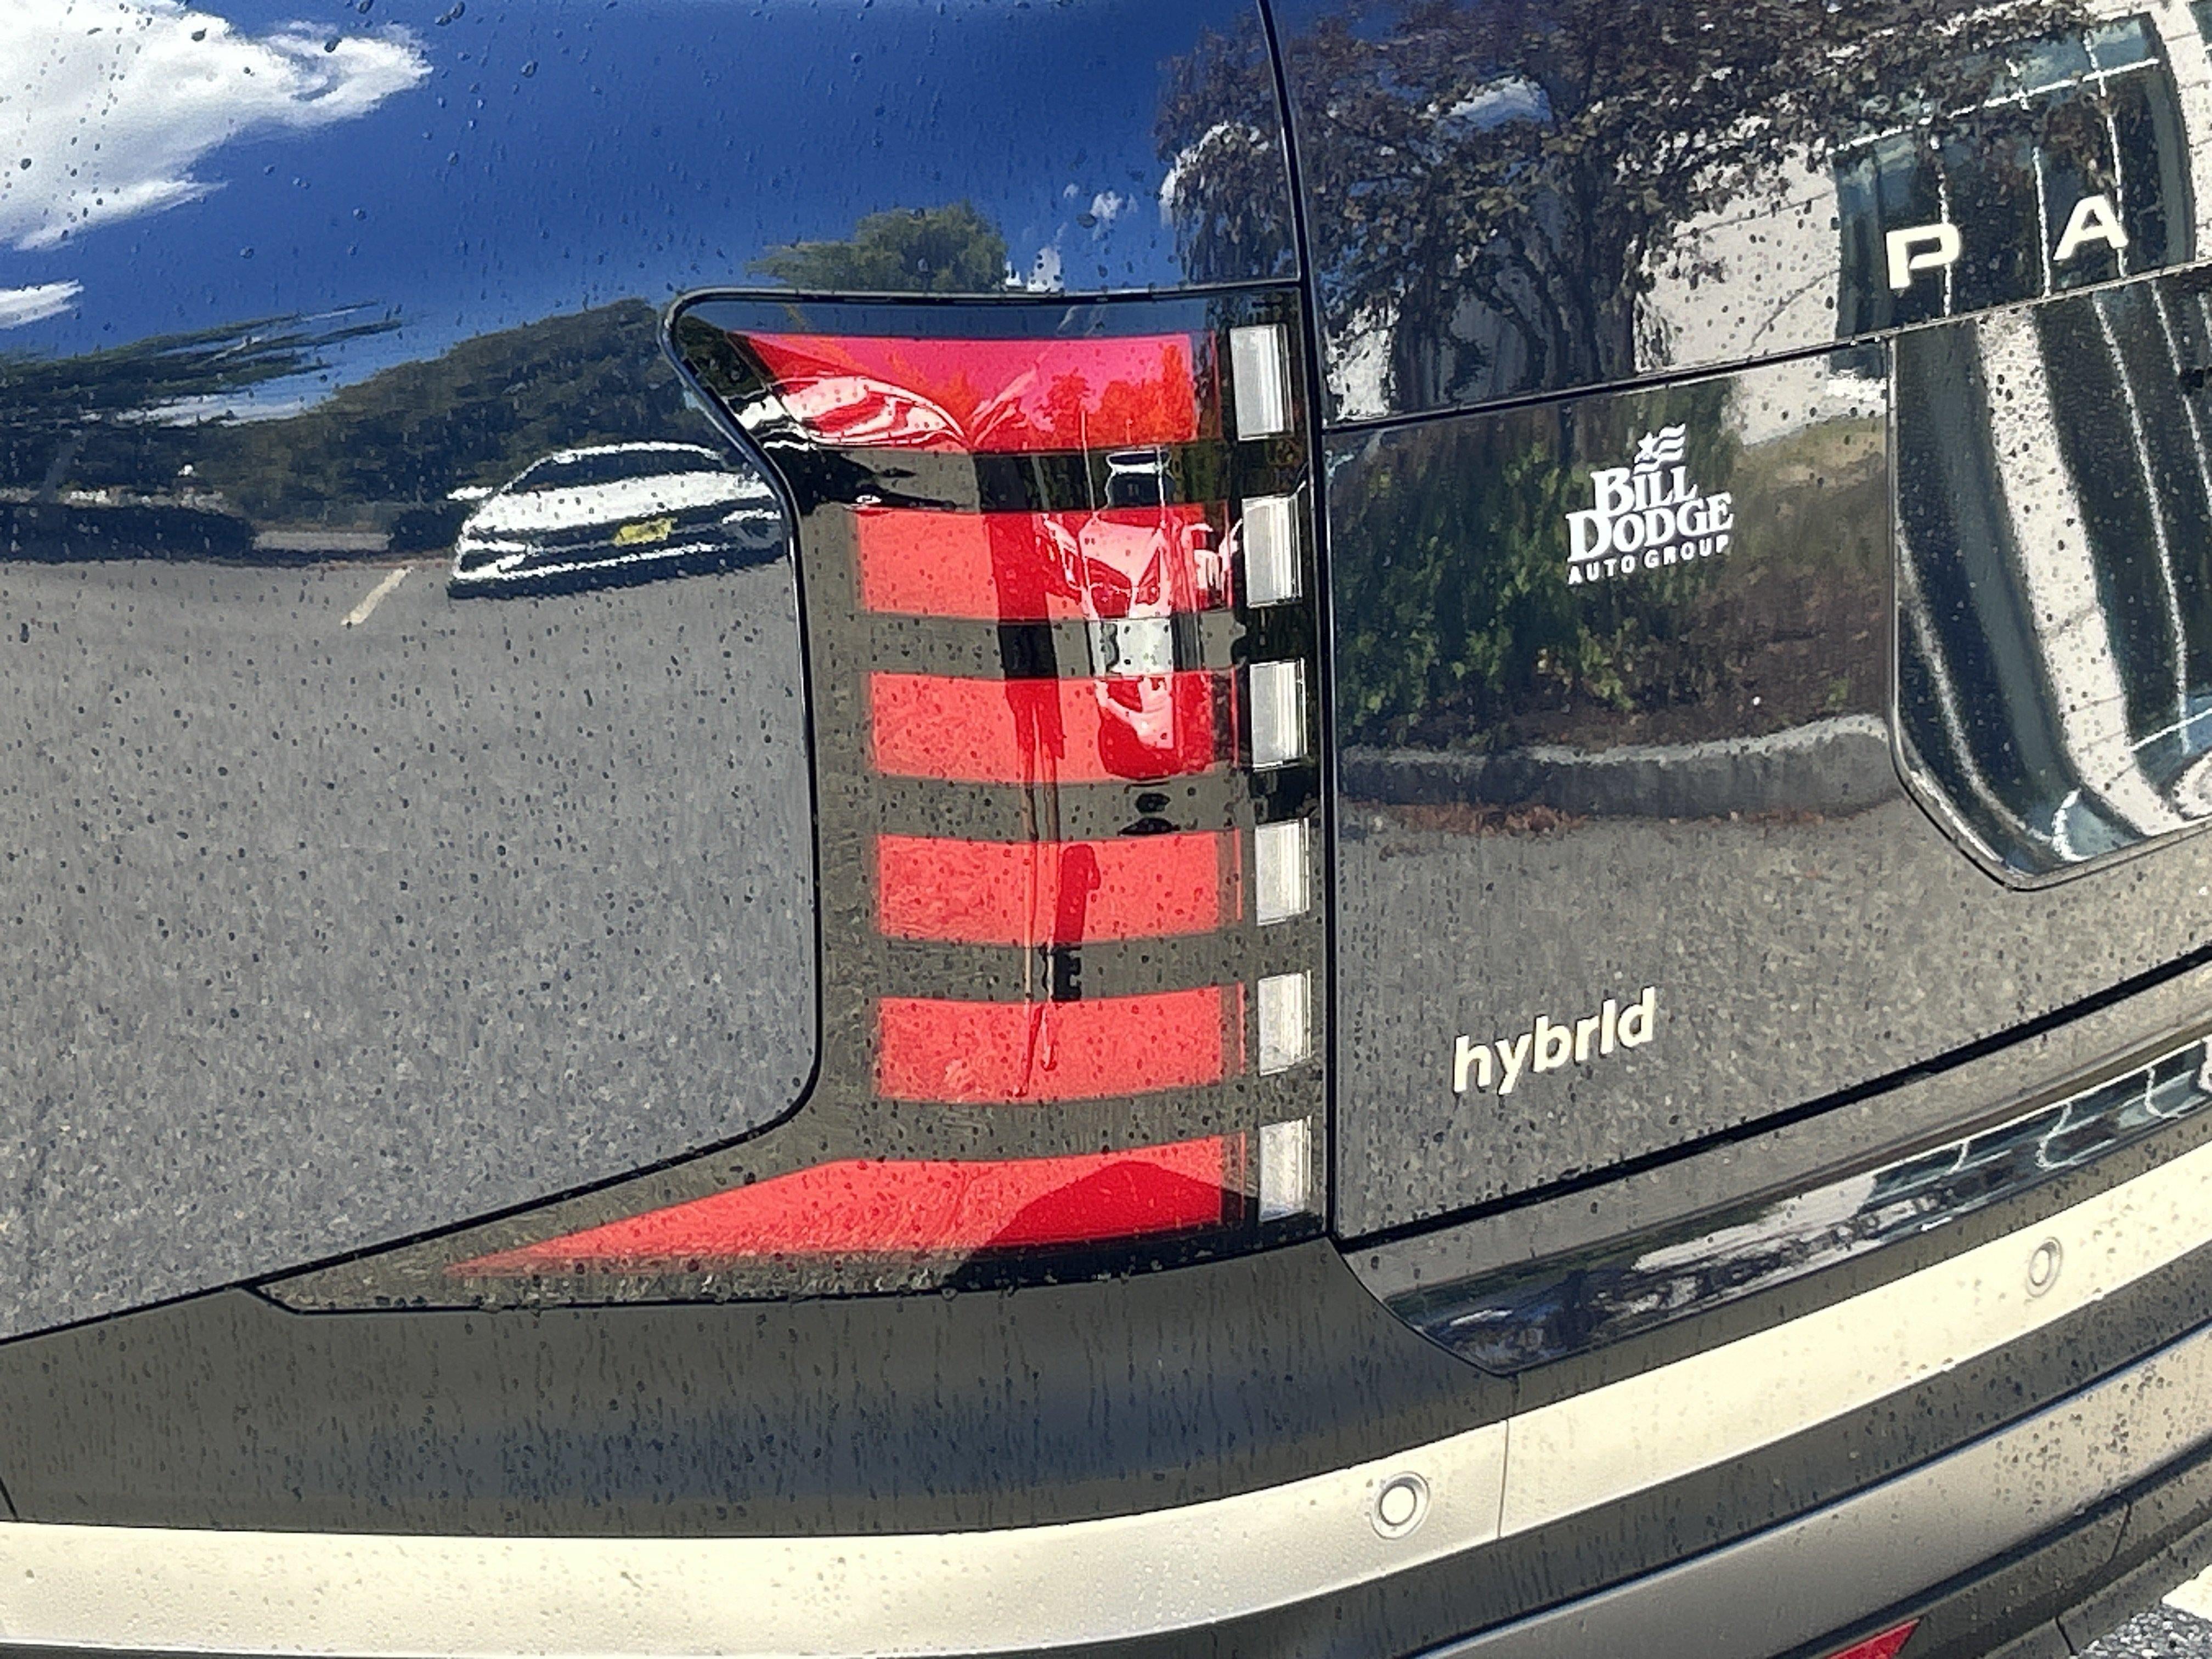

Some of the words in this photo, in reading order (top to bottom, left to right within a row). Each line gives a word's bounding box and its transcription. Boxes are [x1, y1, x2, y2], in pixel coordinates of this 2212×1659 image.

[1565, 492, 1734, 562] DODGE
[1568, 555, 1636, 585] AUTO
[1644, 534, 1729, 569] GROUP
[1453, 986, 1656, 1096] hybrid
